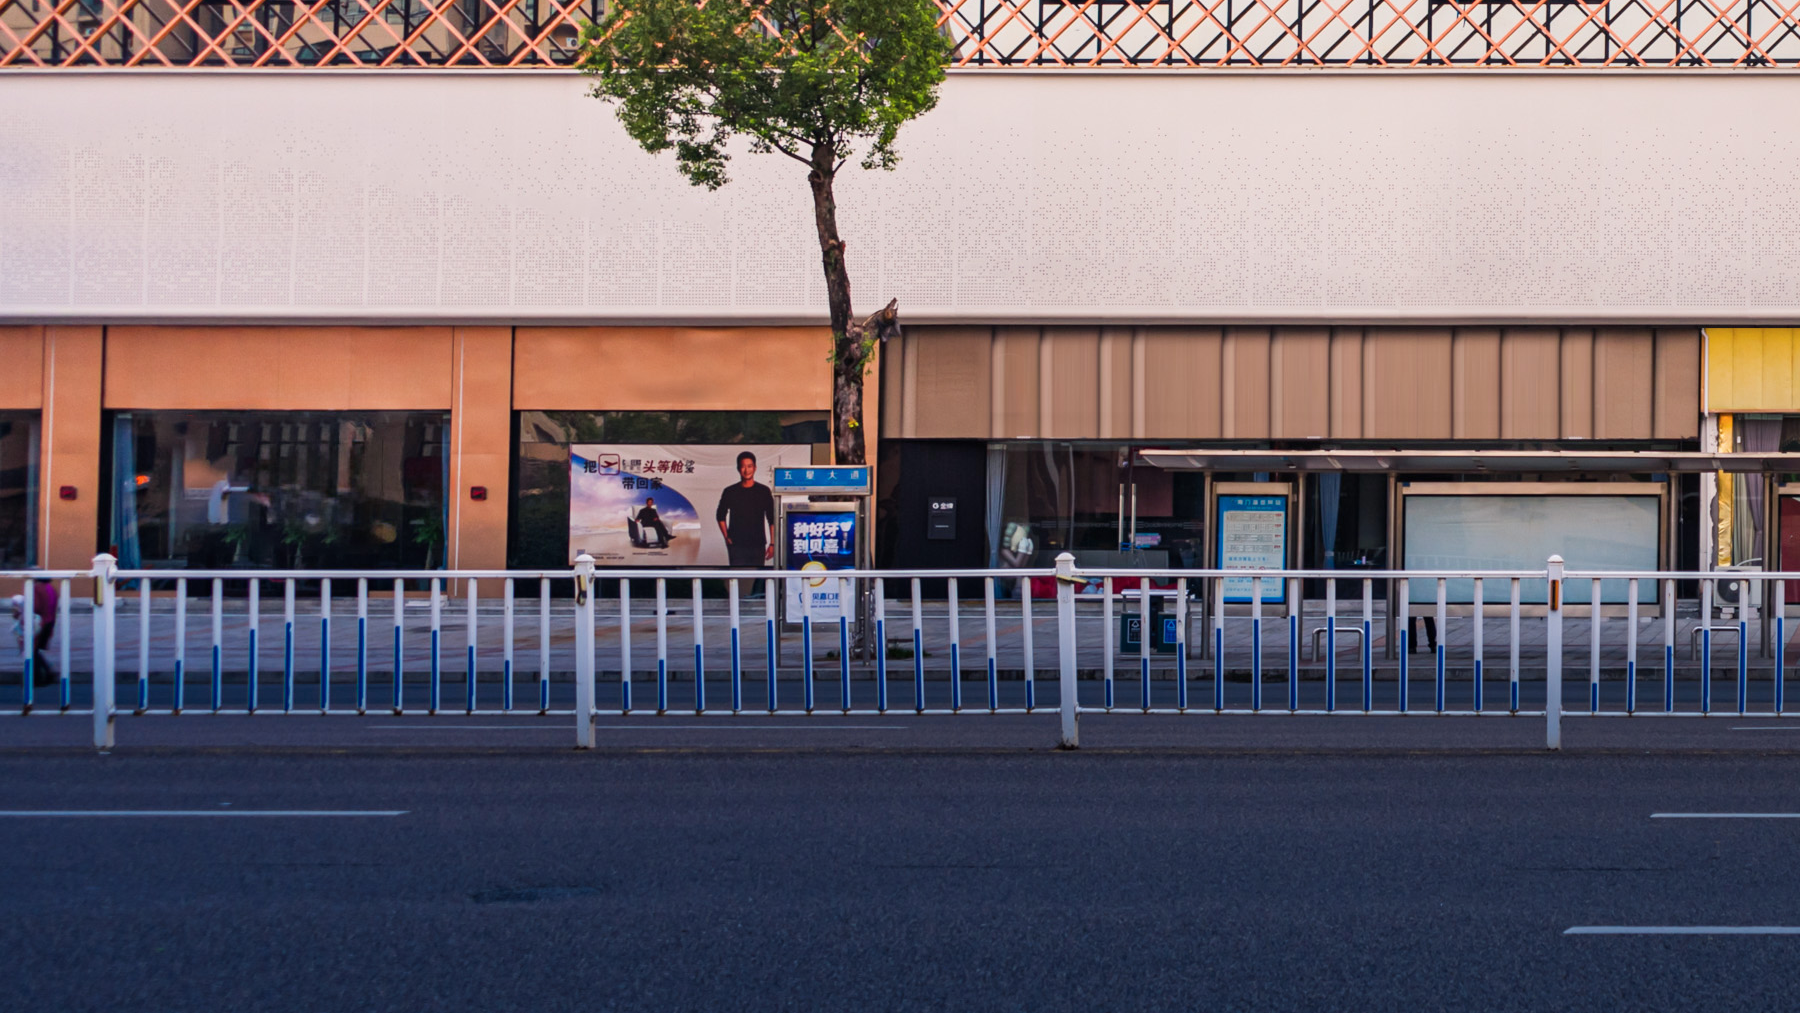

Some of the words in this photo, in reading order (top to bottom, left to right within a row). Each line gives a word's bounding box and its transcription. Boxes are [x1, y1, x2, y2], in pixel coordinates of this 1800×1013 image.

[584, 459, 597, 473] 把
[643, 460, 684, 474] 头等舱
[622, 476, 663, 490] 带回家
[793, 522, 839, 538] 种好牙
[793, 538, 839, 554] 到贝嘉
